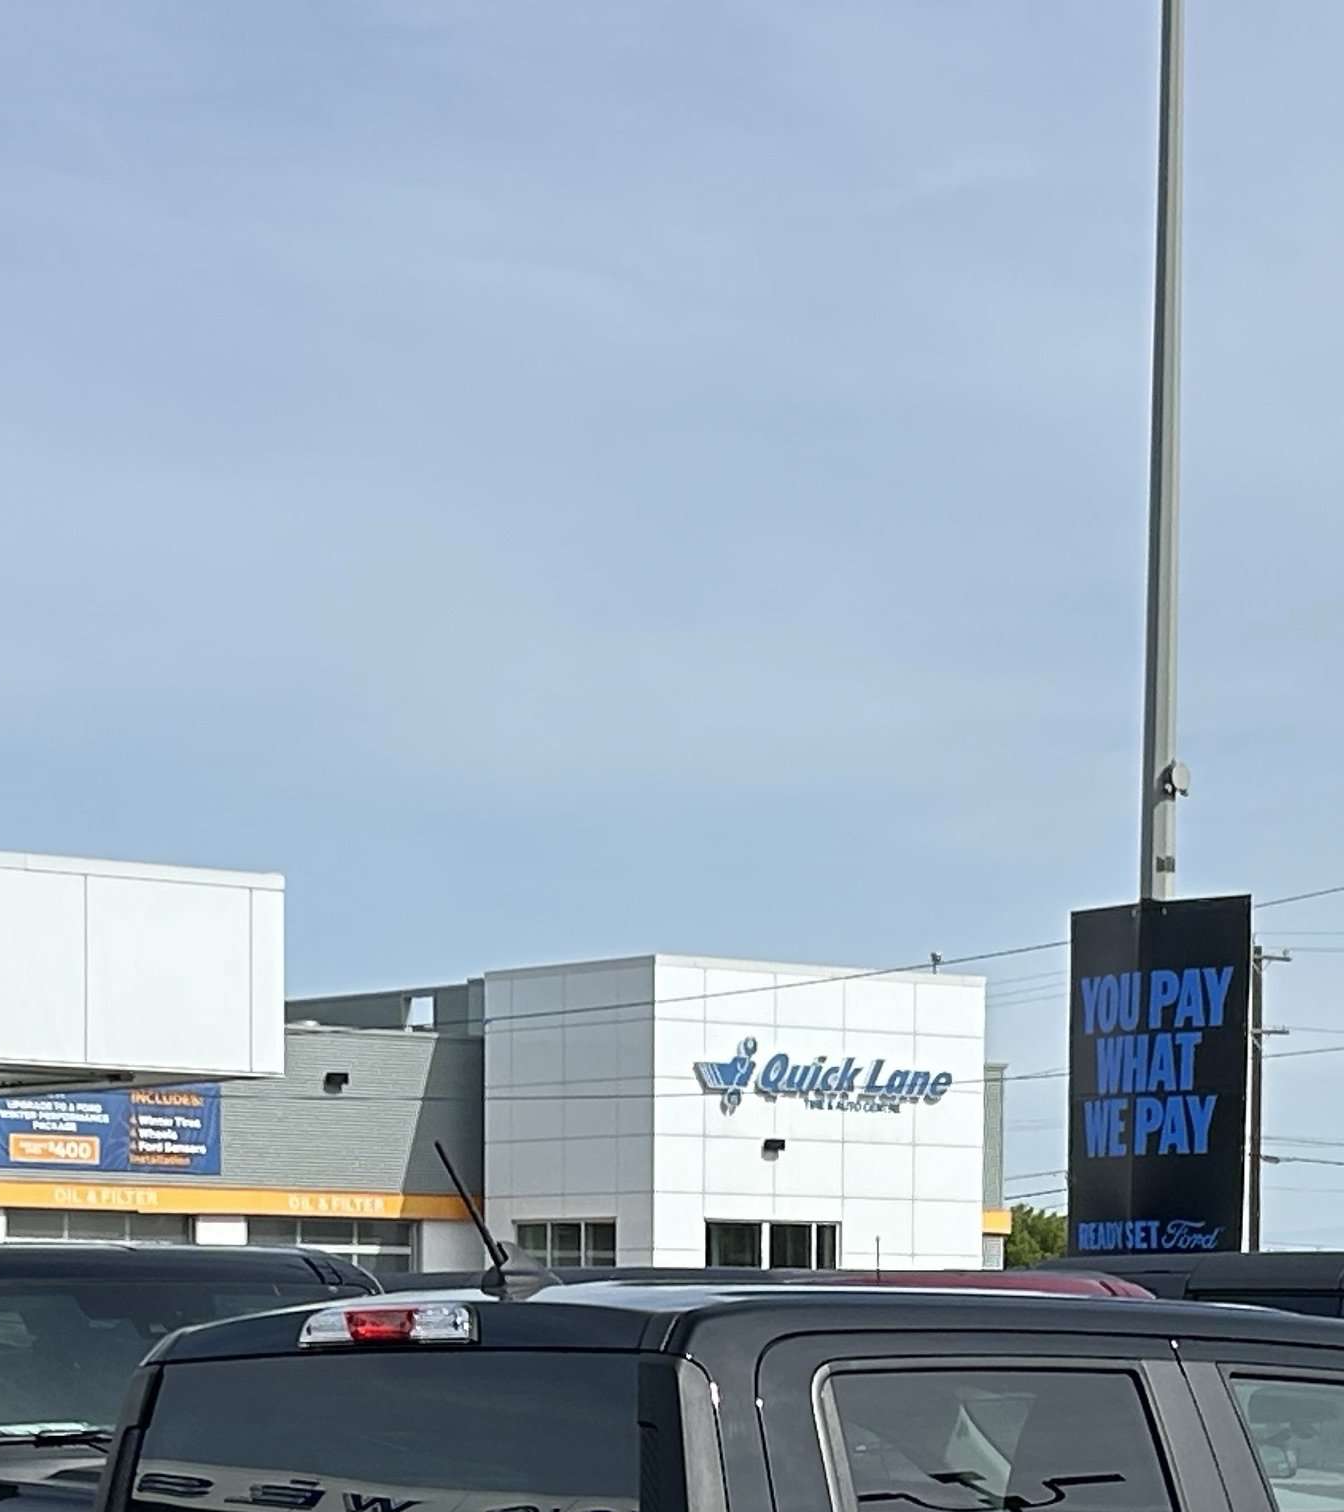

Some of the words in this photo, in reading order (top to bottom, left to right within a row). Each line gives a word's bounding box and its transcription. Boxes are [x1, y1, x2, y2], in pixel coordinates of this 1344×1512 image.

[1081, 971, 1142, 1034] YOU
[1148, 966, 1234, 1028] PAY
[760, 1053, 863, 1096] Quick
[864, 1059, 953, 1099] Lane
[1096, 1032, 1202, 1095] WHAT
[1084, 1099, 1128, 1158] WE
[1134, 1095, 1218, 1155] PAY
[1078, 1222, 1123, 1249] READY
[1124, 1221, 1160, 1249] SET
[1161, 1219, 1219, 1249] Ford
